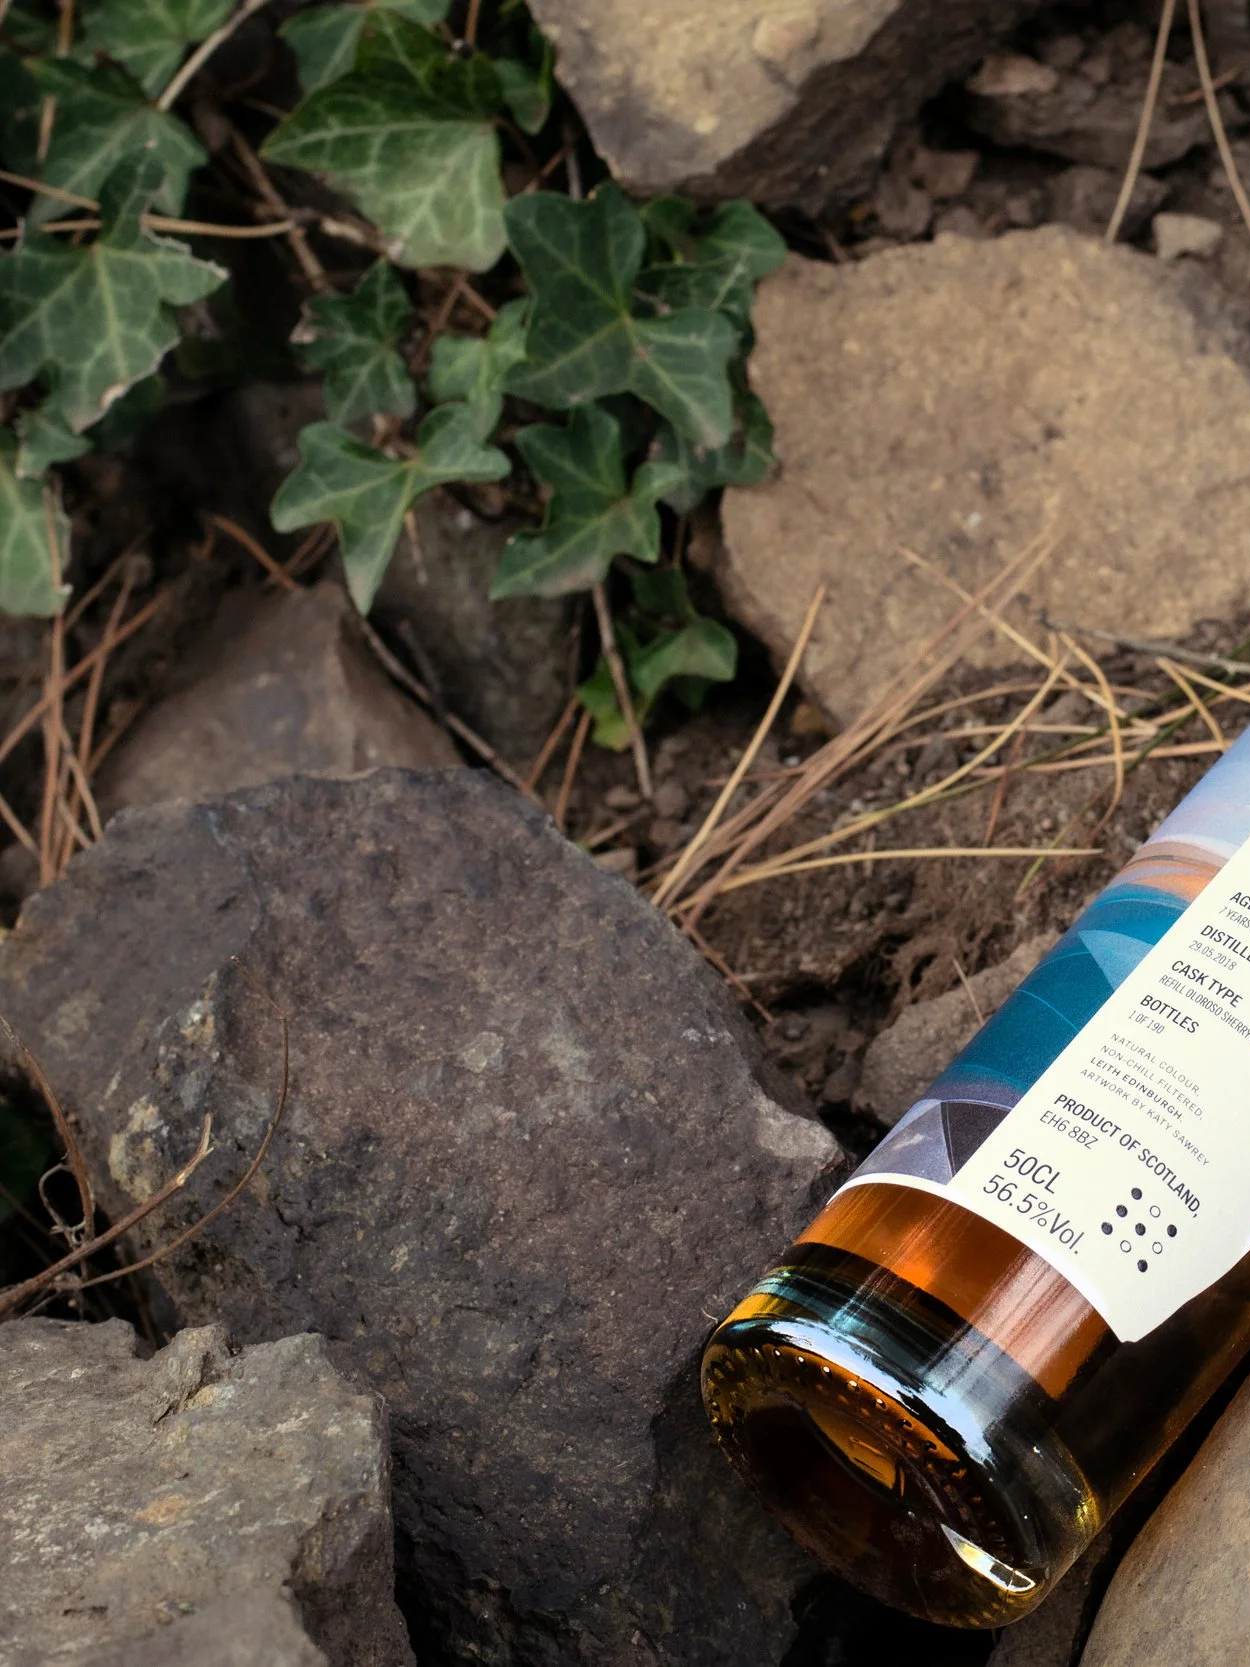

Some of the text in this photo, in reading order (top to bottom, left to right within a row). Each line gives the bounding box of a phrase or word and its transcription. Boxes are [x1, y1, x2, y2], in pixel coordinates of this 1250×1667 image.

[1219, 906, 1228, 914] 7
[1188, 940, 1237, 971] 29.05.2018
[1158, 975, 1185, 995] REFILL
[1185, 988, 1224, 1016] OLOROSO
[1171, 960, 1243, 1008] CASK TYPE
[1128, 1010, 1165, 1034] 1 OF 190
[1140, 994, 1200, 1034] BOTTLES
[1090, 1056, 1121, 1077] LEITH
[1100, 1045, 1154, 1081] NON-CHILL
[1110, 1033, 1156, 1064] NATURAL
[1039, 1110, 1099, 1150] EH6 8BZ
[1080, 1069, 1210, 1167] ARTWORK BY KATY SAWREY
[1003, 1148, 1061, 1194] 50CL
[1053, 1094, 1201, 1218] PRODUCT OF SCOTLAND,
[983, 1174, 1085, 1255] 56.5%Vol.
